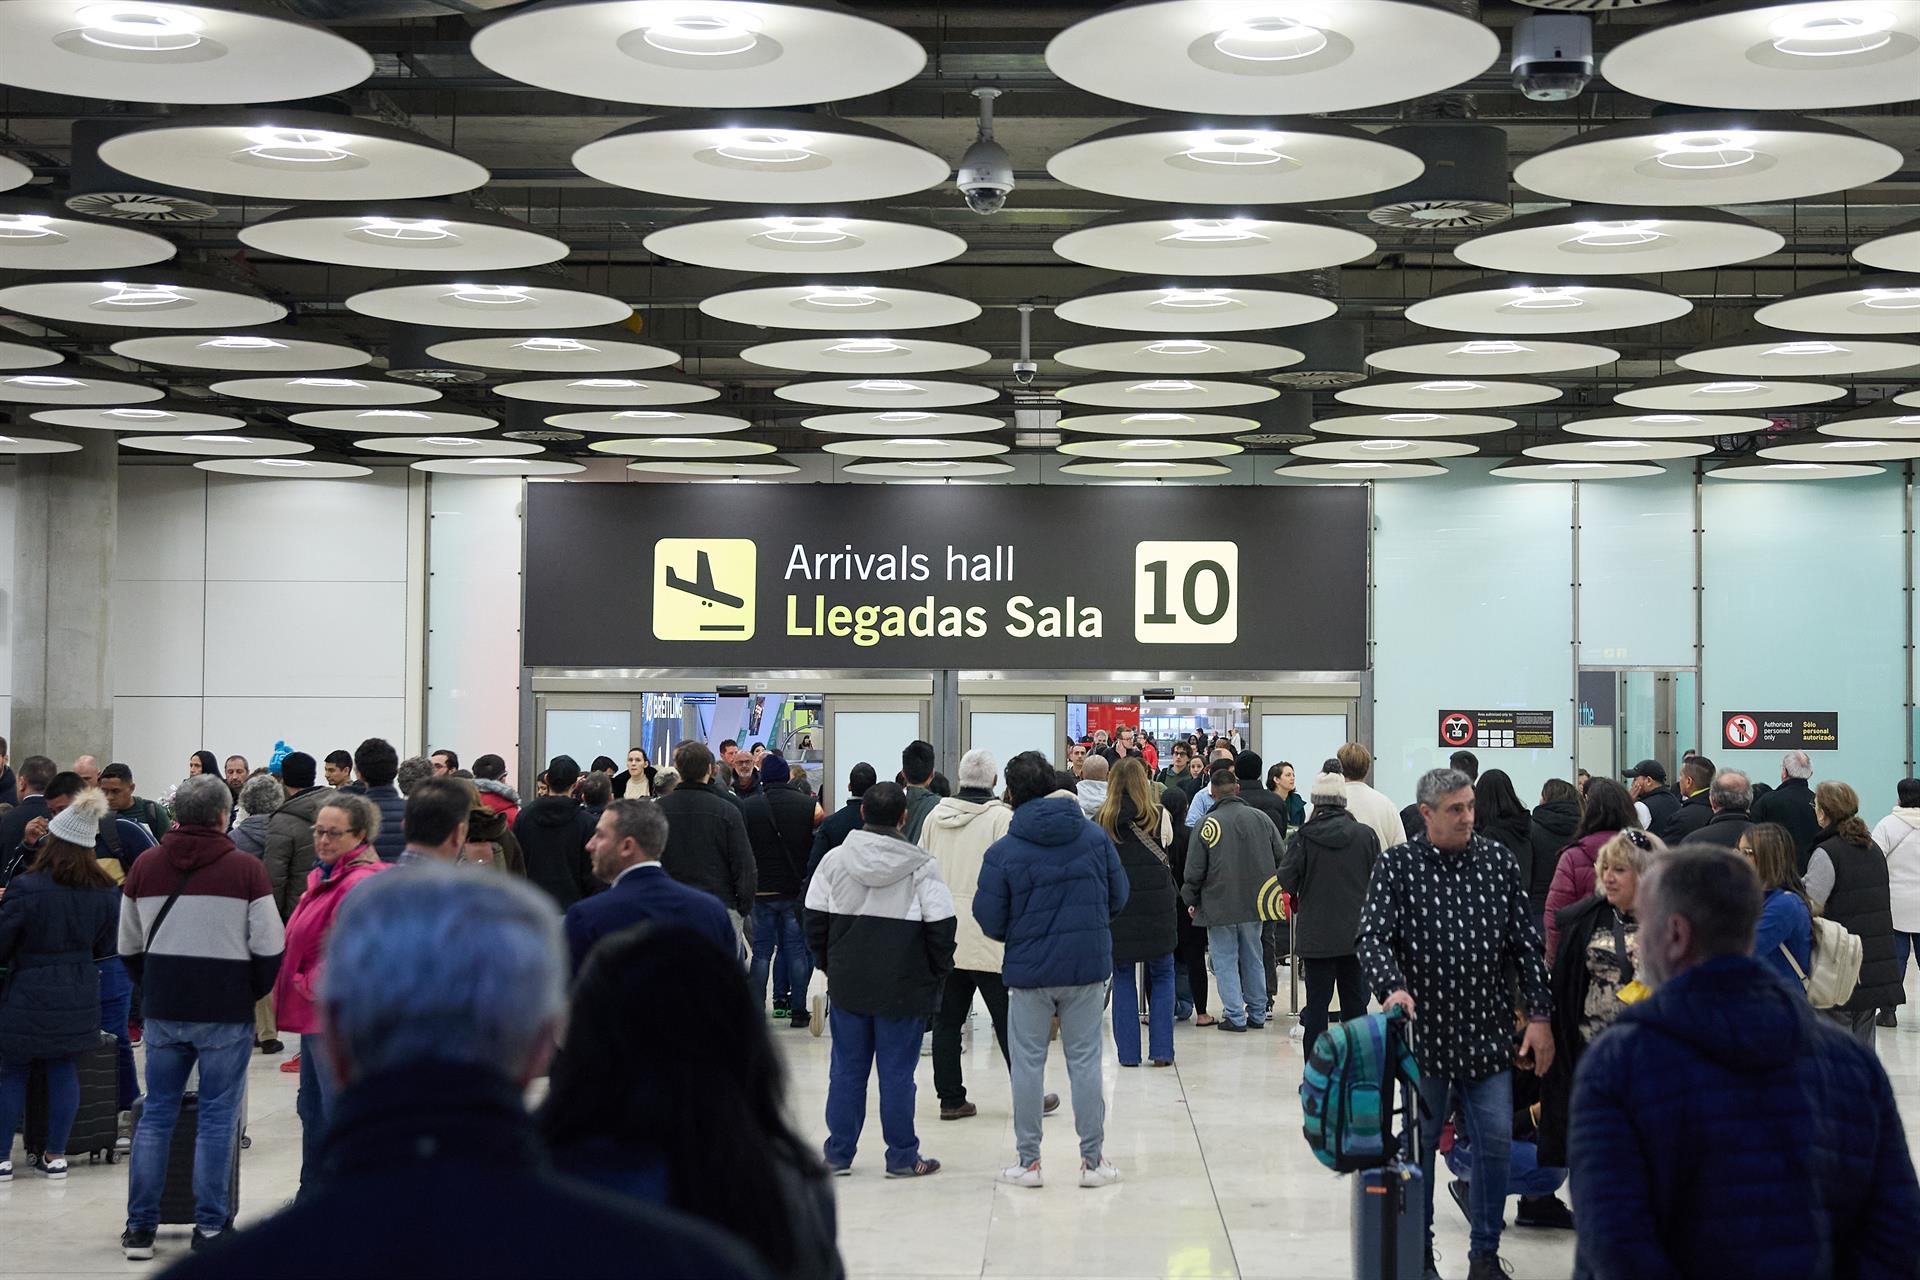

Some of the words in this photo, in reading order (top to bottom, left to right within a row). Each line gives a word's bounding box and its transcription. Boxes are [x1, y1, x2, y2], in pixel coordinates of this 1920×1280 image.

[783, 543, 930, 582] Arrivals
[946, 544, 1014, 582] hall
[1143, 559, 1230, 626] 10
[786, 594, 988, 647] Llegadas
[1004, 595, 1103, 638] Sala
[654, 696, 682, 719] BREITLING
